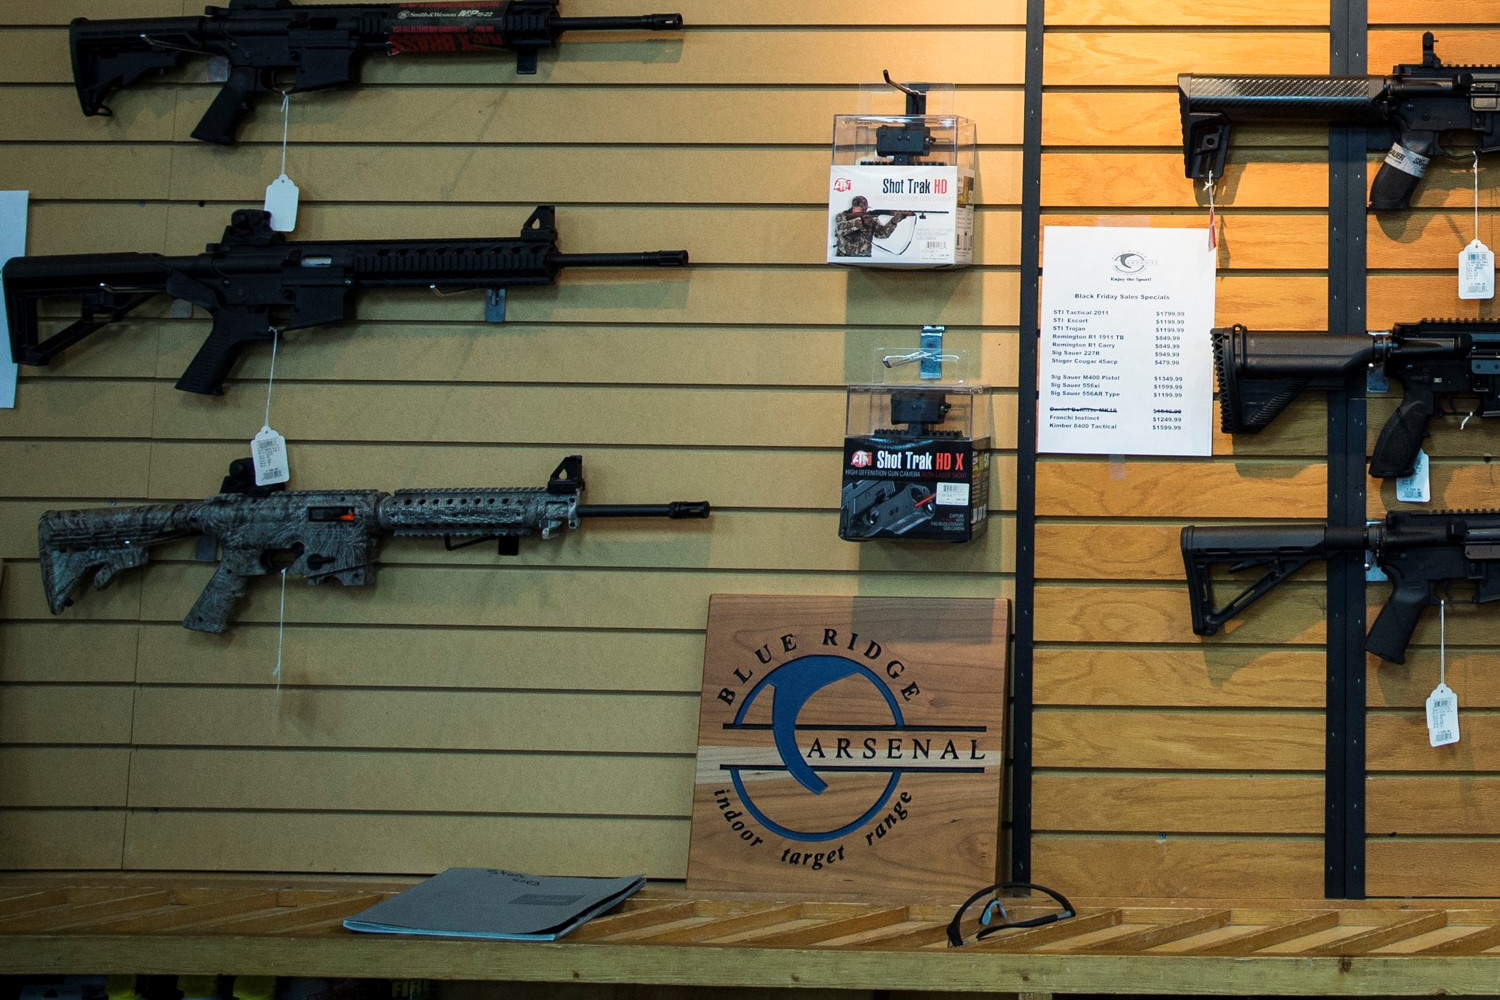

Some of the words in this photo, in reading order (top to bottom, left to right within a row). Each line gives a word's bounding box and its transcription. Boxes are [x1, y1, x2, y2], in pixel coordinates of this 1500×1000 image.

[883, 178, 904, 193] Shot
[908, 179, 930, 194] Trak
[934, 179, 947, 194] HD
[877, 450, 902, 469] Shot
[906, 452, 932, 470] Trak
[936, 453, 951, 470] HD
[955, 453, 964, 470] X
[716, 633, 798, 706] BLUE
[822, 628, 920, 702] RIDGE
[807, 737, 986, 760] ARSENAL
[714, 787, 763, 848] indoor
[780, 844, 845, 870] target
[864, 790, 913, 847] range
